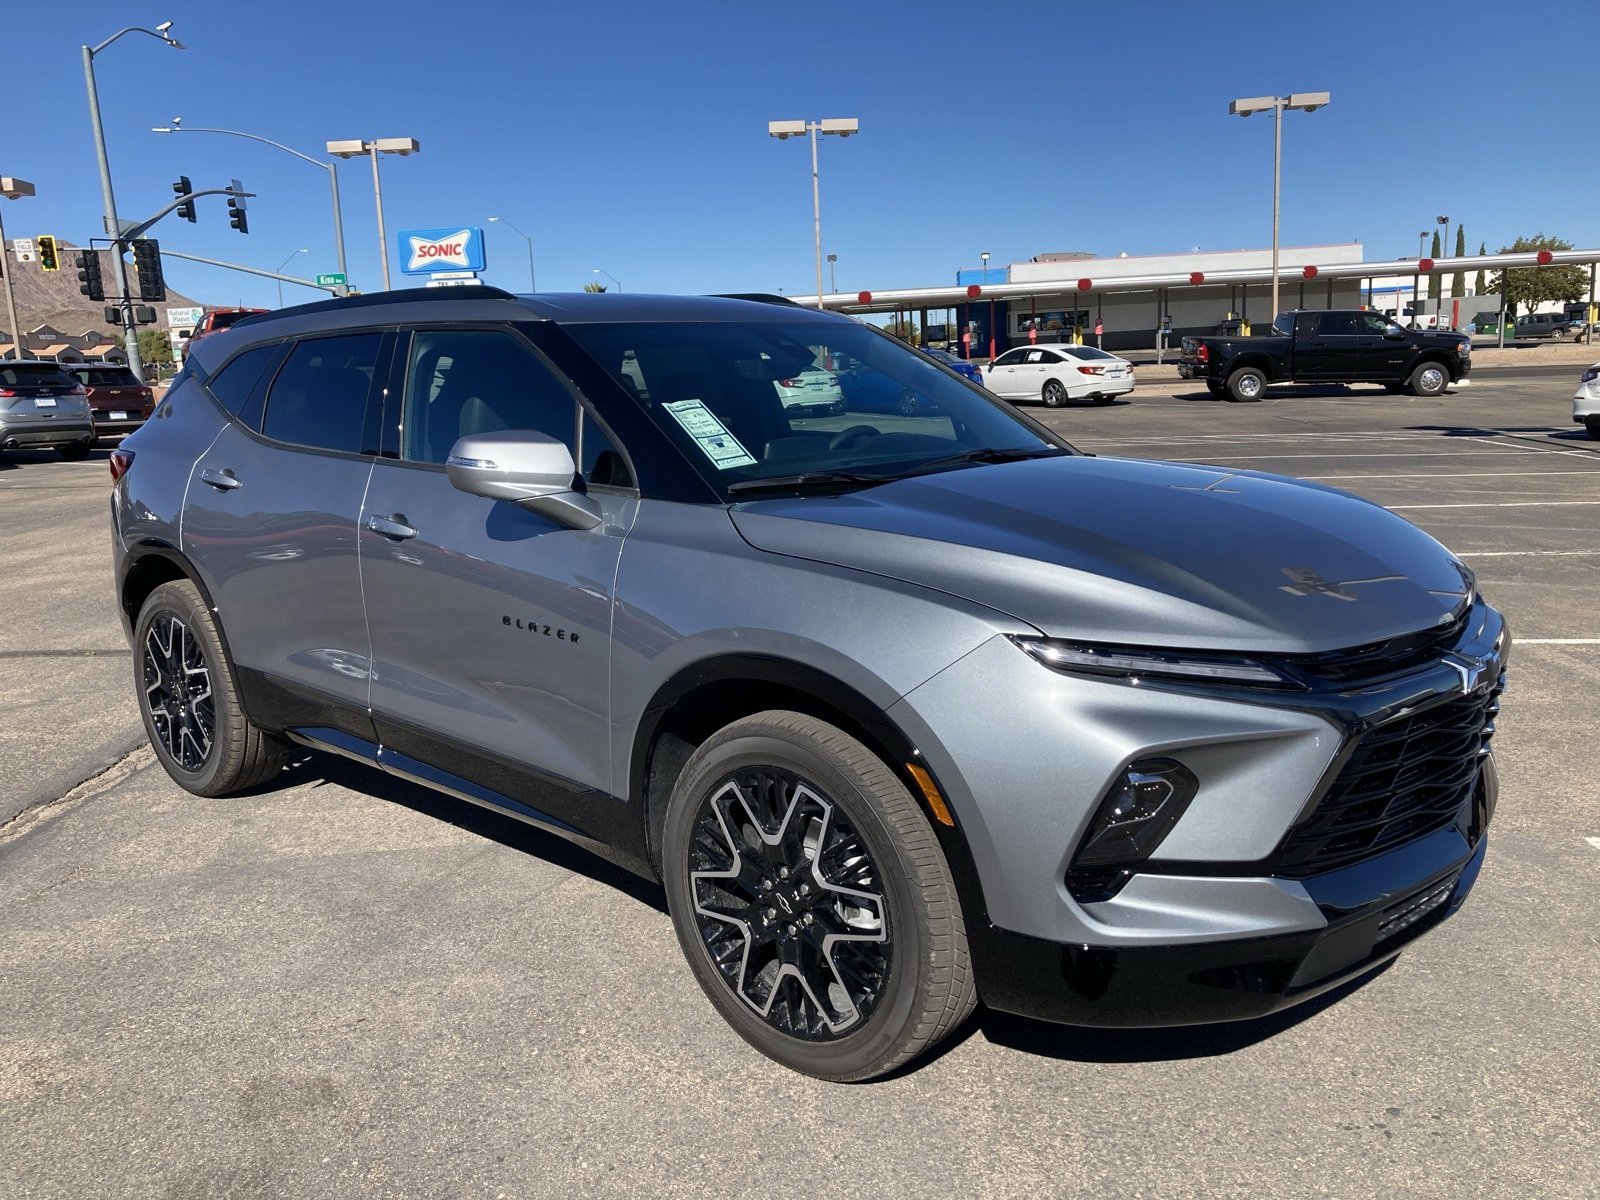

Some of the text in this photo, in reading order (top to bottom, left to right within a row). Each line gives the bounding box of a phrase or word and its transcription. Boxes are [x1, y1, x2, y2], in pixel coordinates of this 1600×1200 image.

[417, 243, 462, 258] SONIC
[320, 275, 335, 284] Kino
[502, 615, 579, 644] BLAZER
